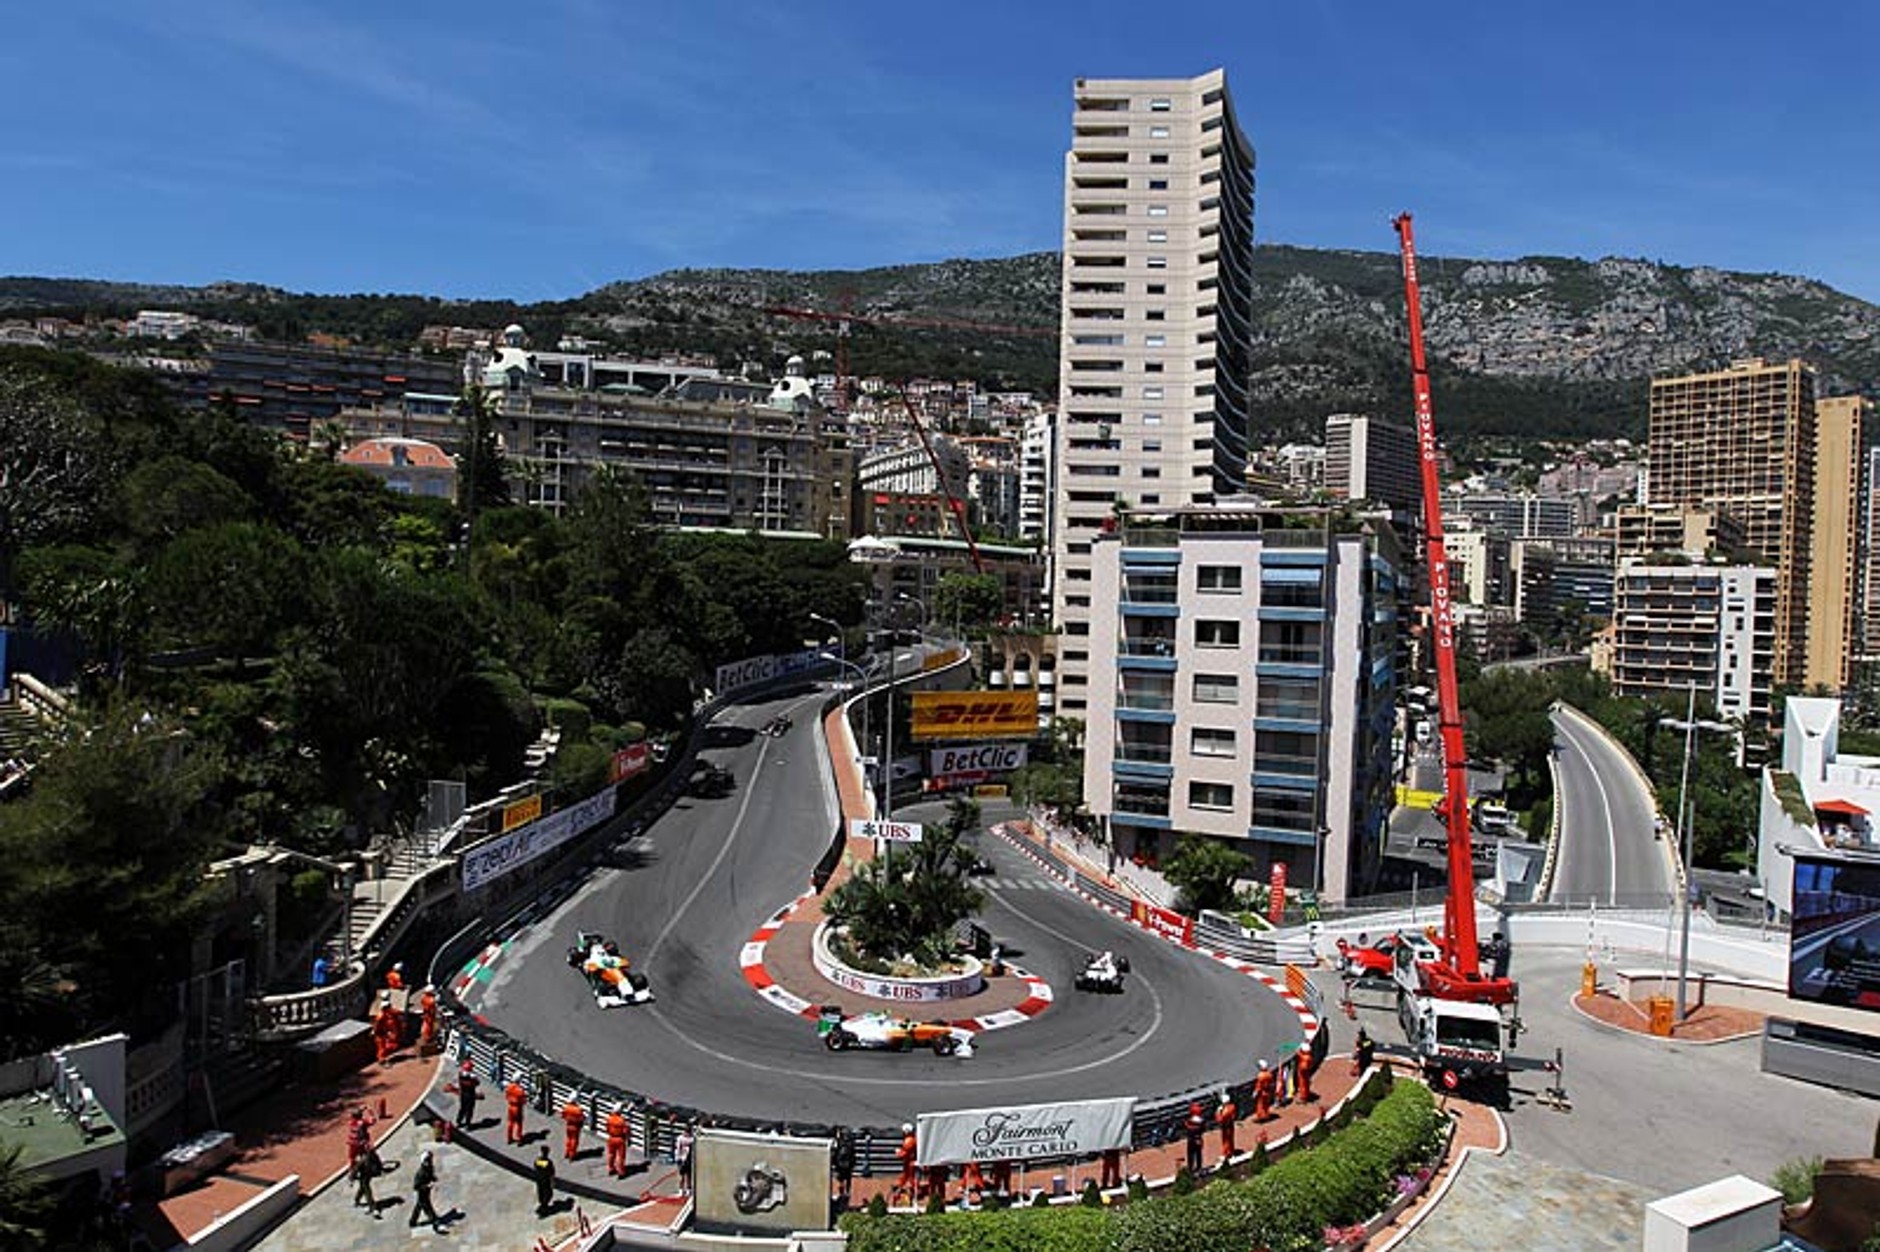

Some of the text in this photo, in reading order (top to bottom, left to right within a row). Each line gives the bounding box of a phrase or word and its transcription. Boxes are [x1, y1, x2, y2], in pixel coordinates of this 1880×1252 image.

[1435, 561, 1452, 648] PIOVANO
[933, 702, 1018, 724] DHL
[942, 745, 1017, 772] BetClic
[878, 825, 912, 839] UBS
[841, 974, 866, 990] UBS
[892, 984, 923, 999] UBS
[972, 1112, 1075, 1147] Fairmont
[971, 1141, 1078, 1159] MONTE CARLO
